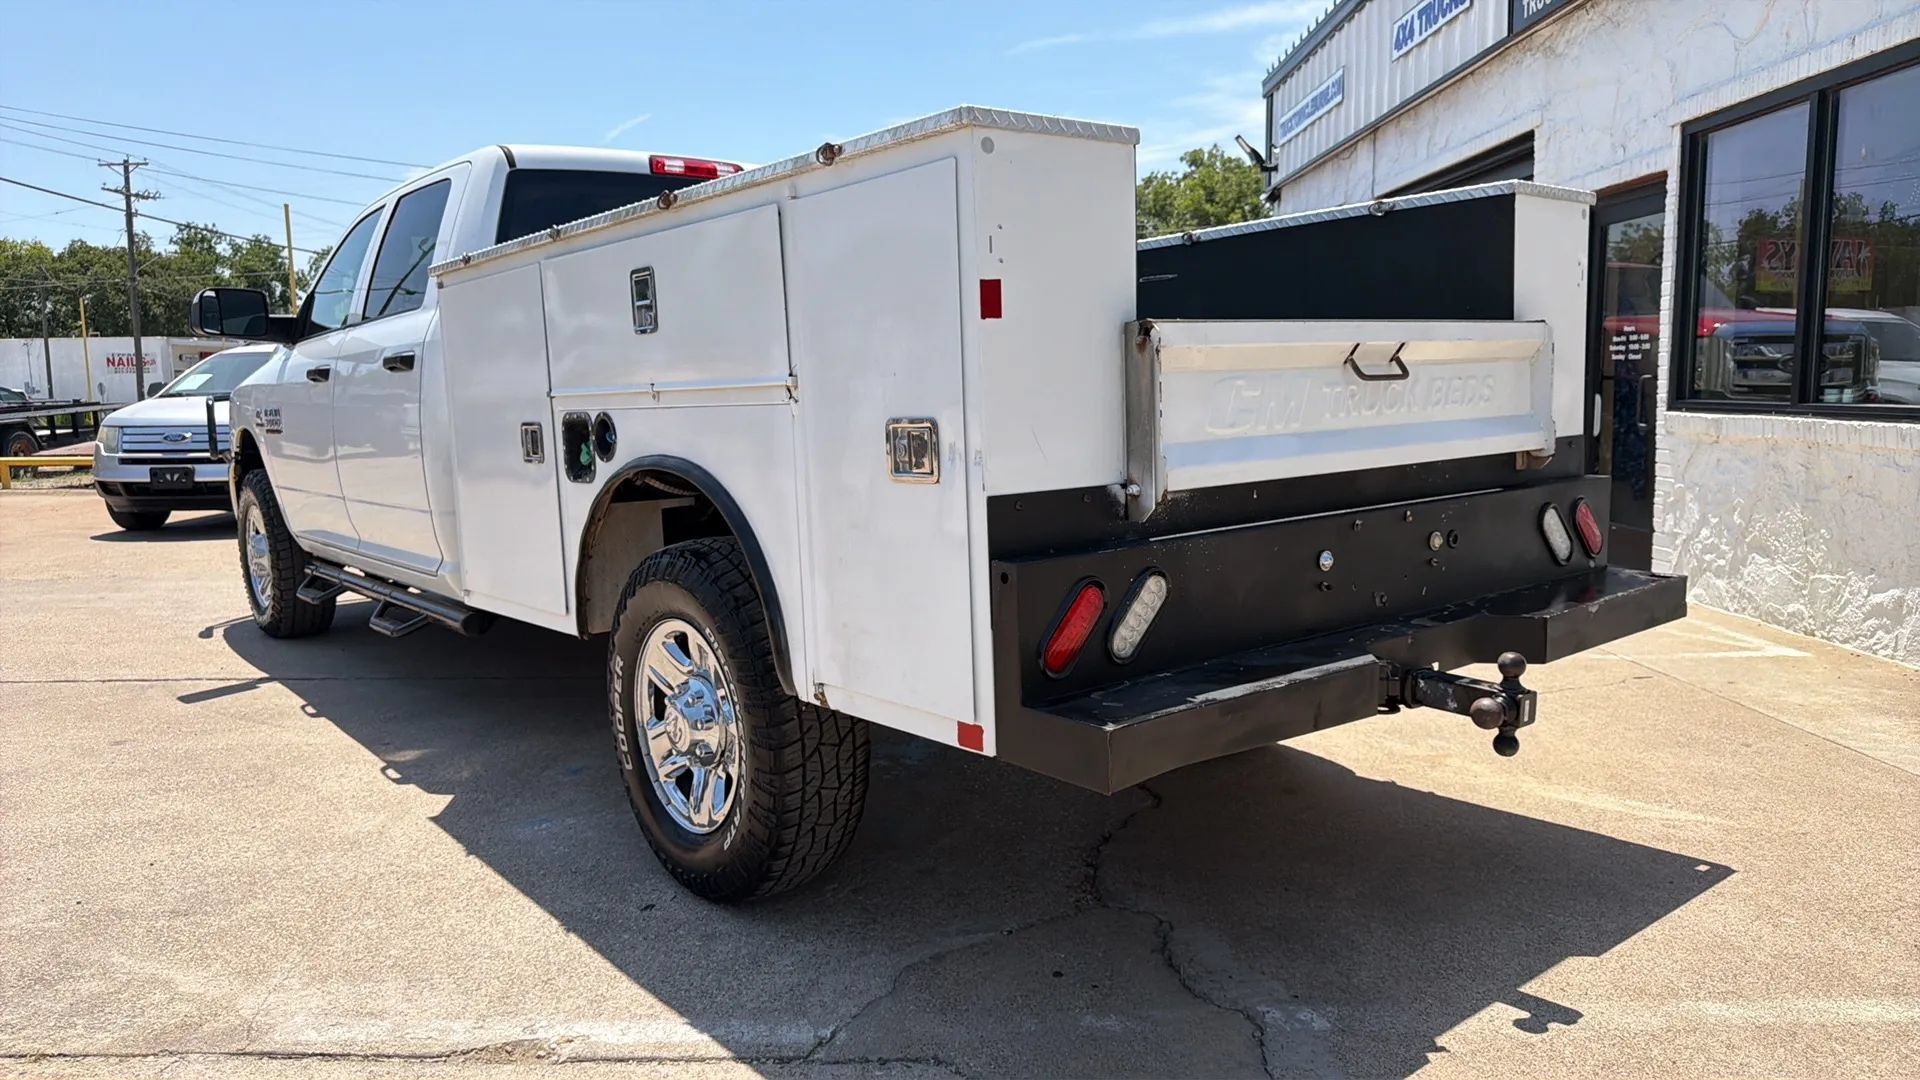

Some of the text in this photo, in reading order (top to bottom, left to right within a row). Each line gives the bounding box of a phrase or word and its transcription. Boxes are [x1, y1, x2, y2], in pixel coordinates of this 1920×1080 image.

[1322, 382, 1418, 418] TRUCK
[1427, 374, 1495, 409] BEDS
[614, 654, 633, 771] COOPER
